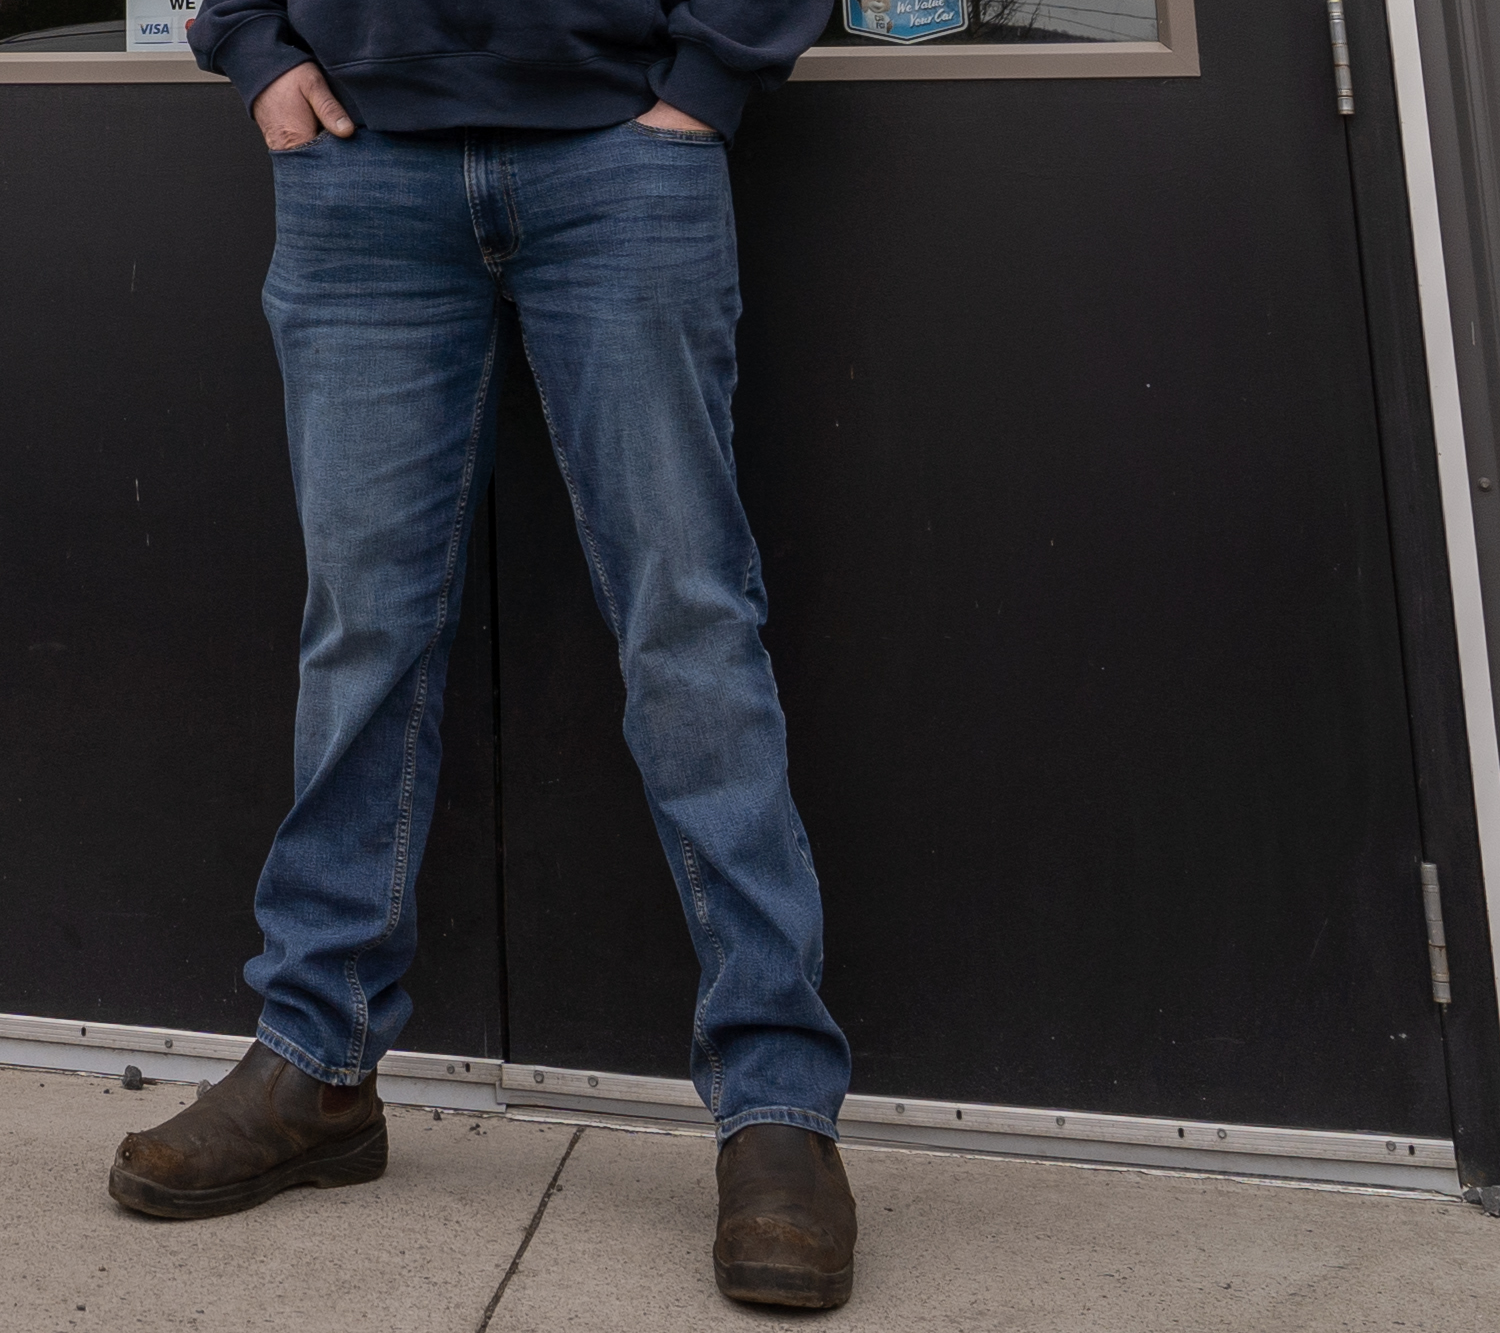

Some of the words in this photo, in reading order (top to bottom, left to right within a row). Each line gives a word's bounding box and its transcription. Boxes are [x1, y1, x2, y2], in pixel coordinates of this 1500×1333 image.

[896, 0, 912, 14] We
[910, 14, 933, 28] Your
[935, 9, 955, 22] Car
[139, 23, 170, 35] VISA
